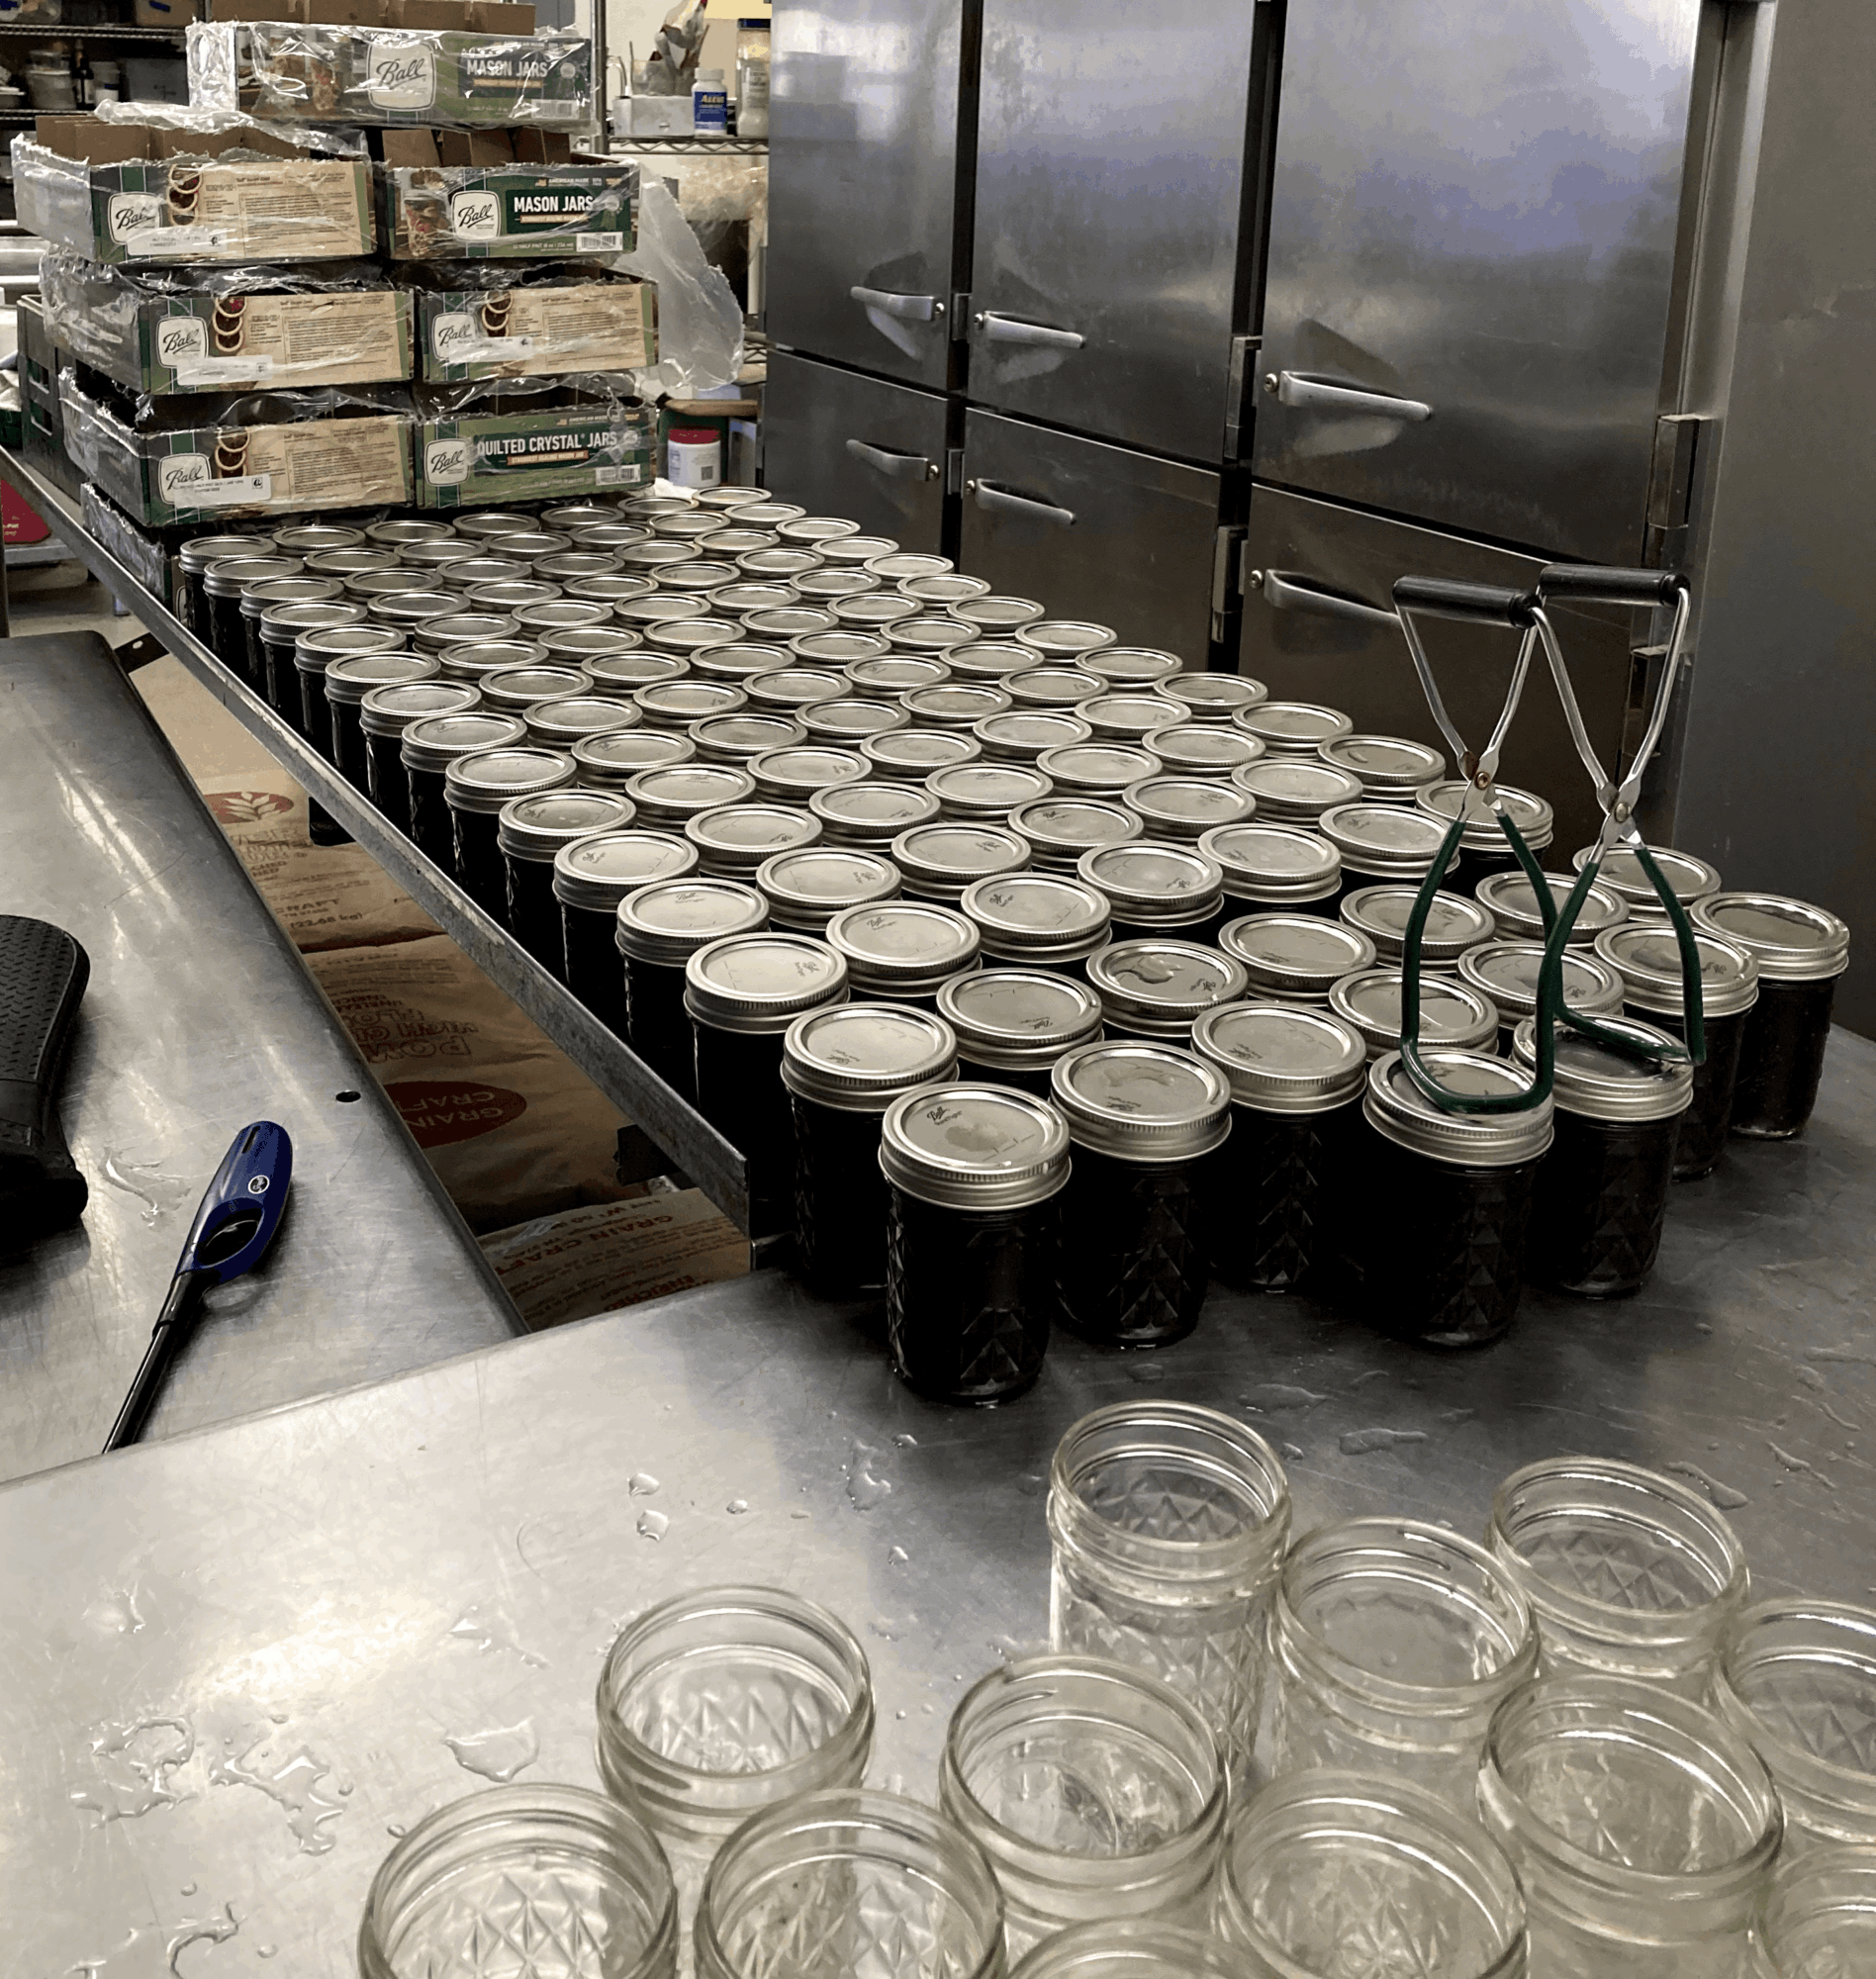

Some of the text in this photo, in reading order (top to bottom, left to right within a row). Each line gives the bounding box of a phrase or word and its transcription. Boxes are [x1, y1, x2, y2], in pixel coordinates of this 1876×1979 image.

[376, 58, 426, 89] Ball
[467, 59, 548, 77] MASON JARS
[458, 204, 495, 229] Ball
[514, 195, 594, 213] MASON JARS
[438, 324, 473, 347] Ball
[478, 431, 617, 456] QUILTED CRYSTAL JARS
[430, 448, 464, 475] Ball
